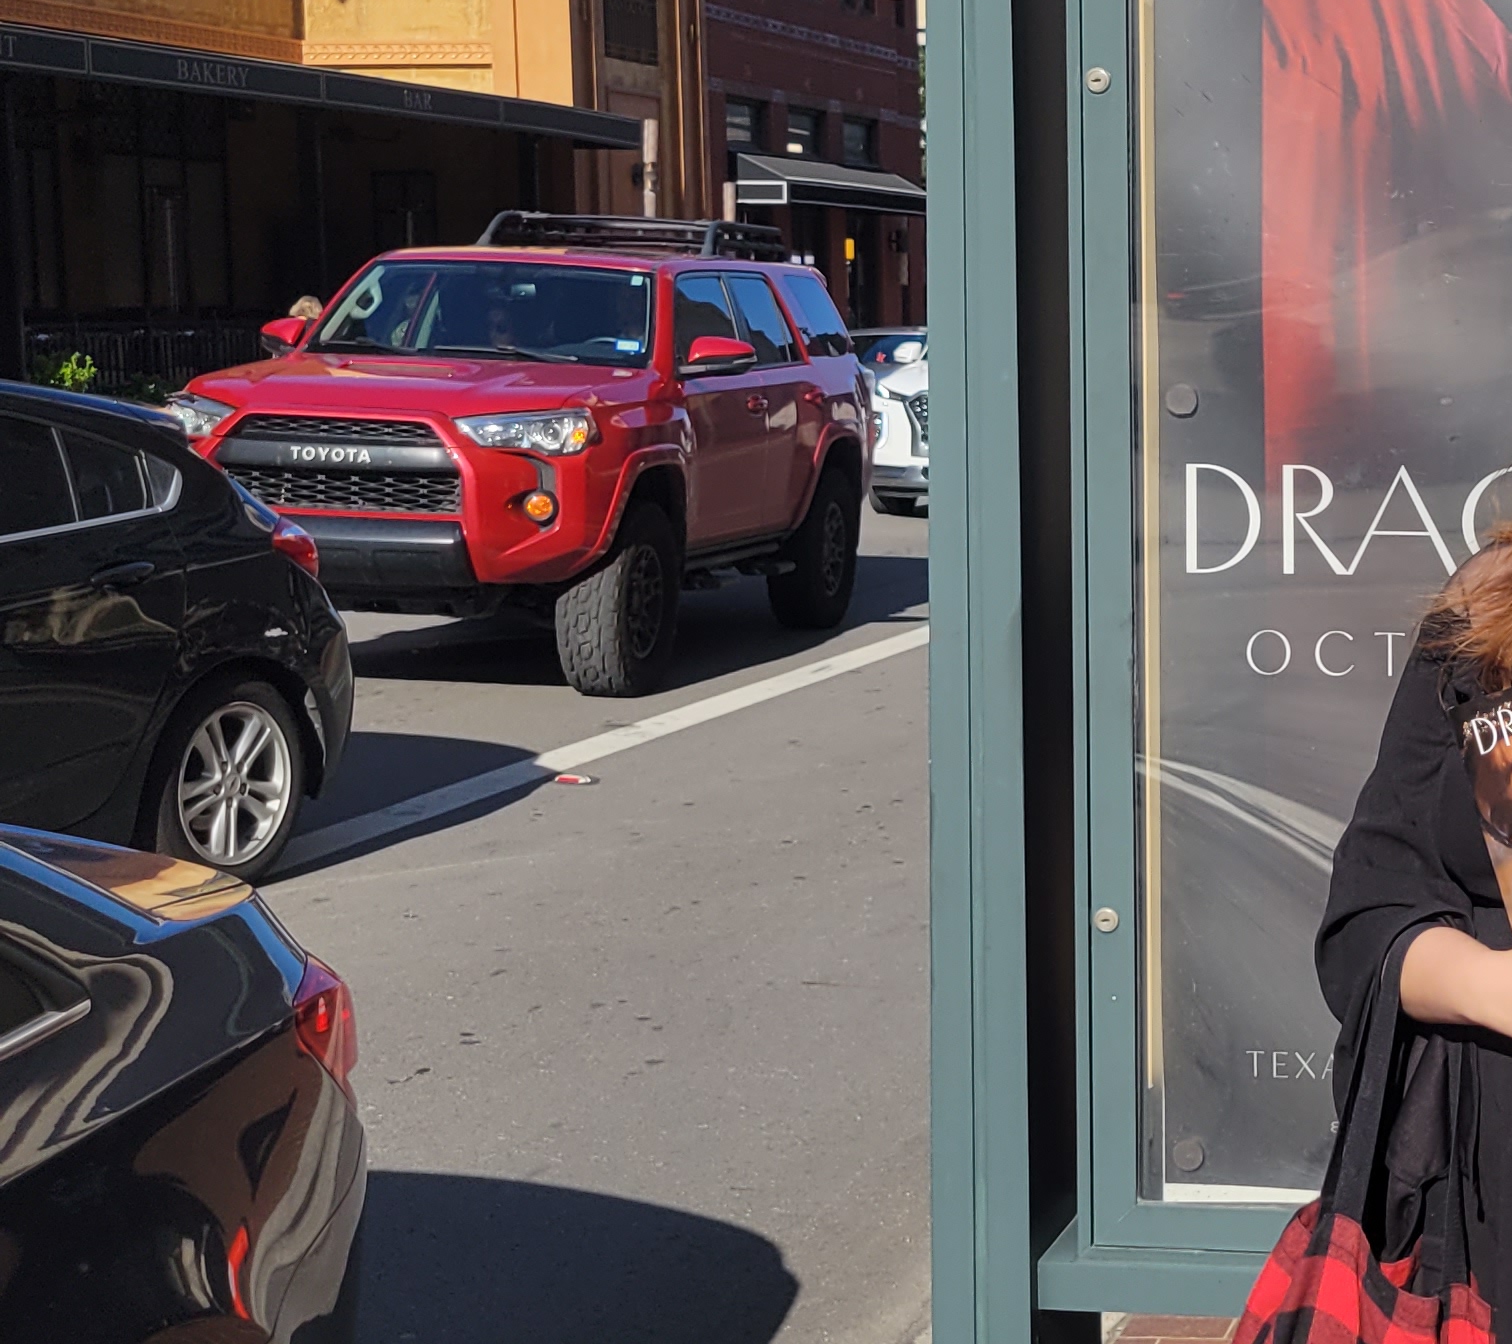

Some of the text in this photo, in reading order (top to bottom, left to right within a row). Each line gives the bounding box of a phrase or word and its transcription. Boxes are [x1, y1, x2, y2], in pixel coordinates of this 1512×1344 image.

[177, 59, 249, 88] BAKERY
[403, 89, 432, 110] BAR
[290, 445, 371, 464] TOYOTA
[1245, 1050, 1335, 1080] TEXA
